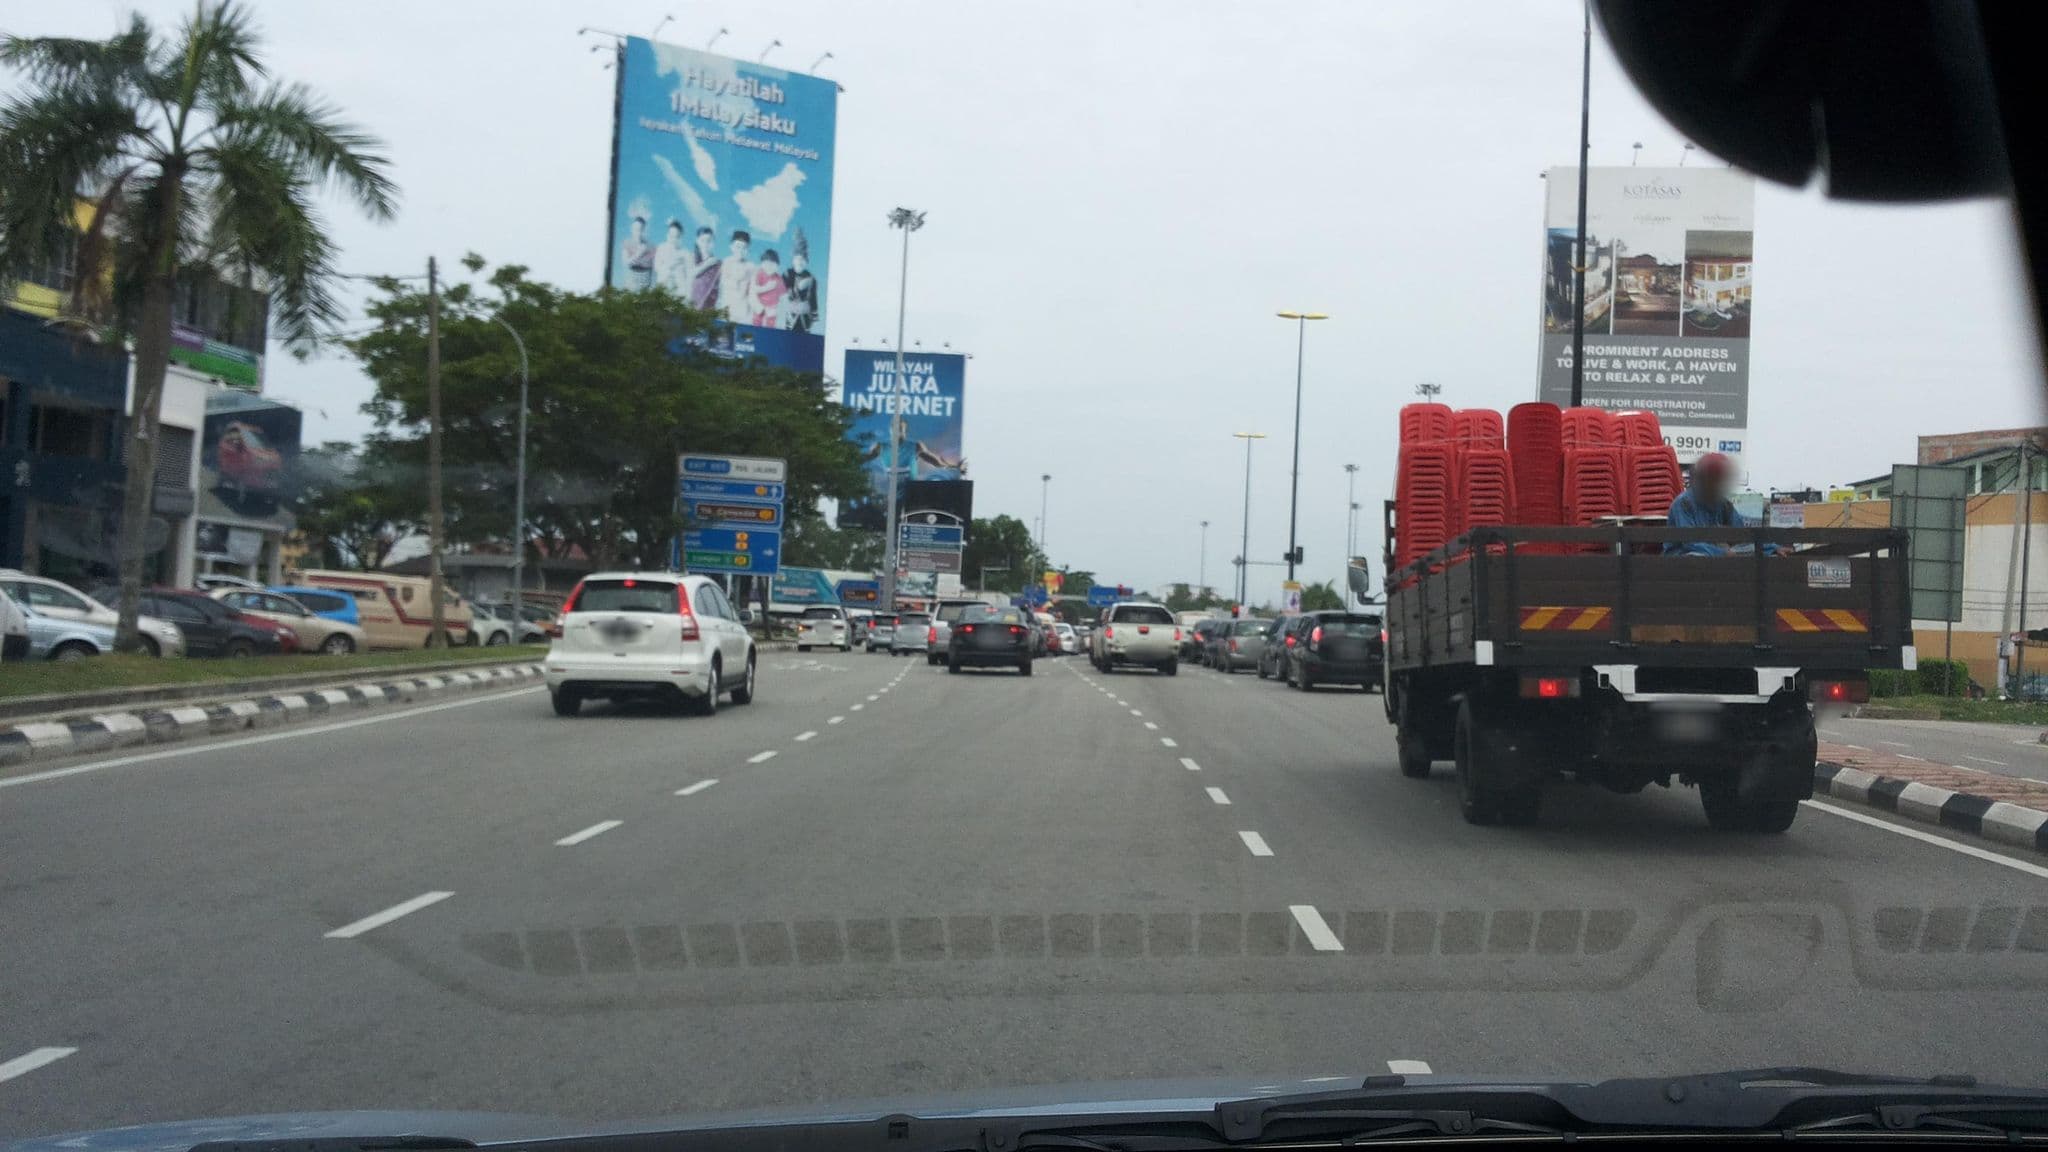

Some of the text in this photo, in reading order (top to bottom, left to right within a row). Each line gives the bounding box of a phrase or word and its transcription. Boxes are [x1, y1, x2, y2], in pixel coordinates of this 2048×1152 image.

[685, 68, 785, 105] Hayatilah
[1563, 345, 1729, 359] A ROMINENT ADDRESS
[873, 360, 934, 375] WILAYAH
[1612, 359, 1622, 369] &
[1626, 360, 1671, 372] WORK,
[1675, 361, 1685, 371] A
[1689, 362, 1737, 372] HAVEN
[867, 373, 939, 395] JUARA
[1584, 372, 1707, 385] TO RELAX & PLAY
[850, 392, 956, 417] INTERNET
[1581, 399, 1706, 410] OPEN FOR REGISTRATION
[1688, 411, 1735, 420] Commercial
[1676, 436, 1711, 449] 9901
